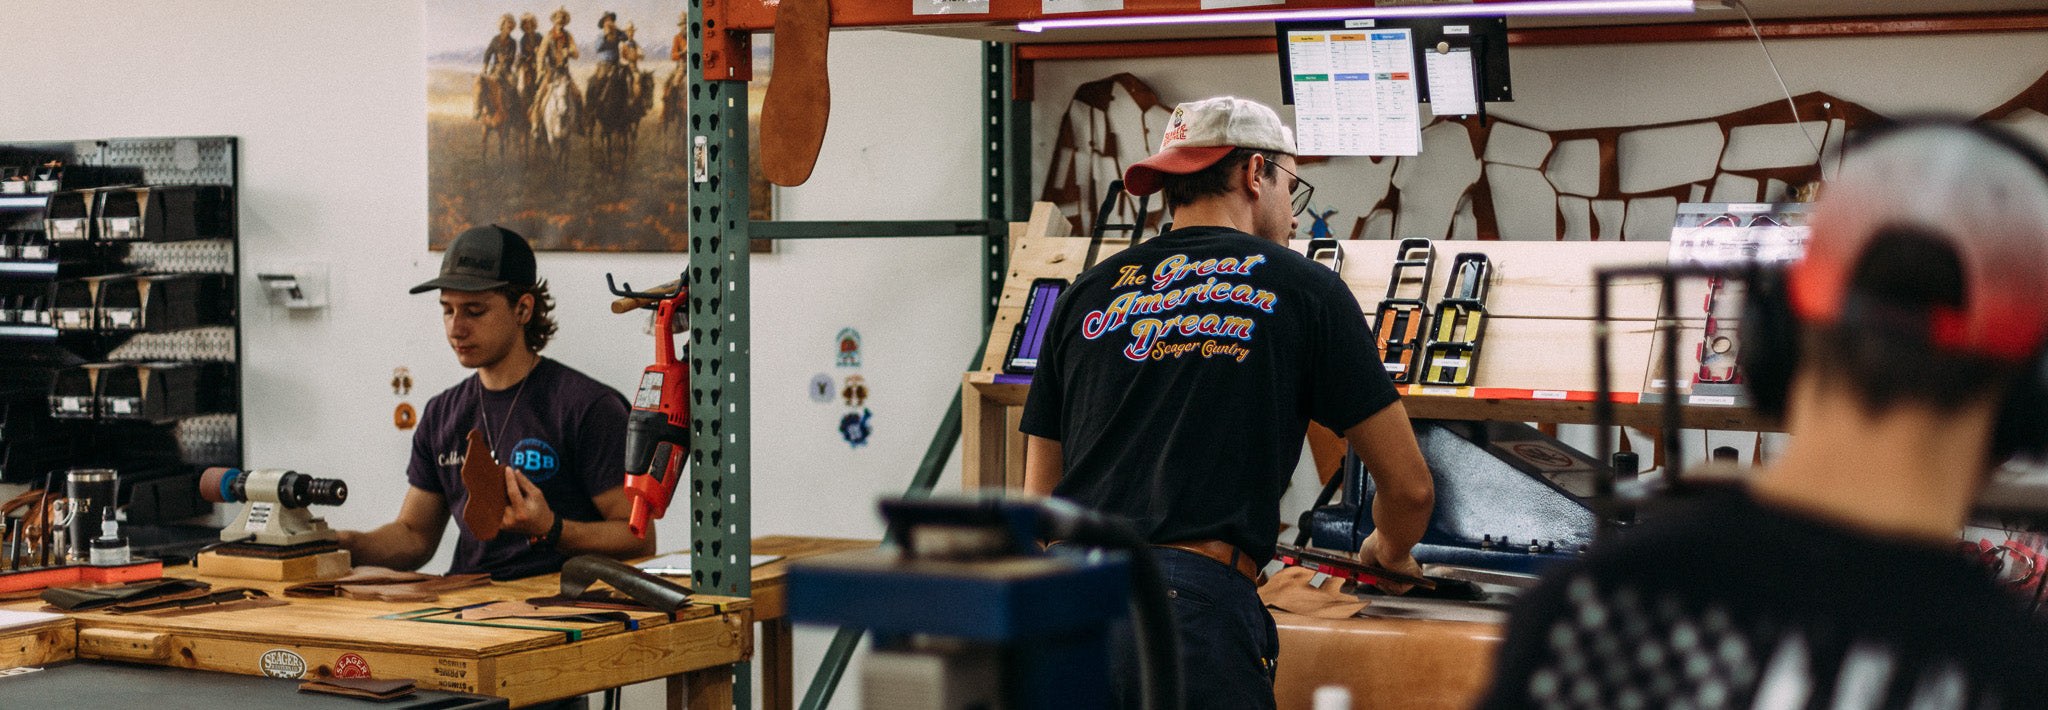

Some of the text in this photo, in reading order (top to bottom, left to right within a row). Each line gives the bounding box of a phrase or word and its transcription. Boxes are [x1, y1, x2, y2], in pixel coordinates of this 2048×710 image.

[1110, 253, 1267, 291] The Great
[1082, 277, 1278, 339] American
[1123, 313, 1256, 361] Dream
[1151, 341, 1200, 360] Seager
[514, 450, 555, 470] BBB
[264, 652, 301, 669] SEAGER
[337, 656, 368, 673] SEAGER
